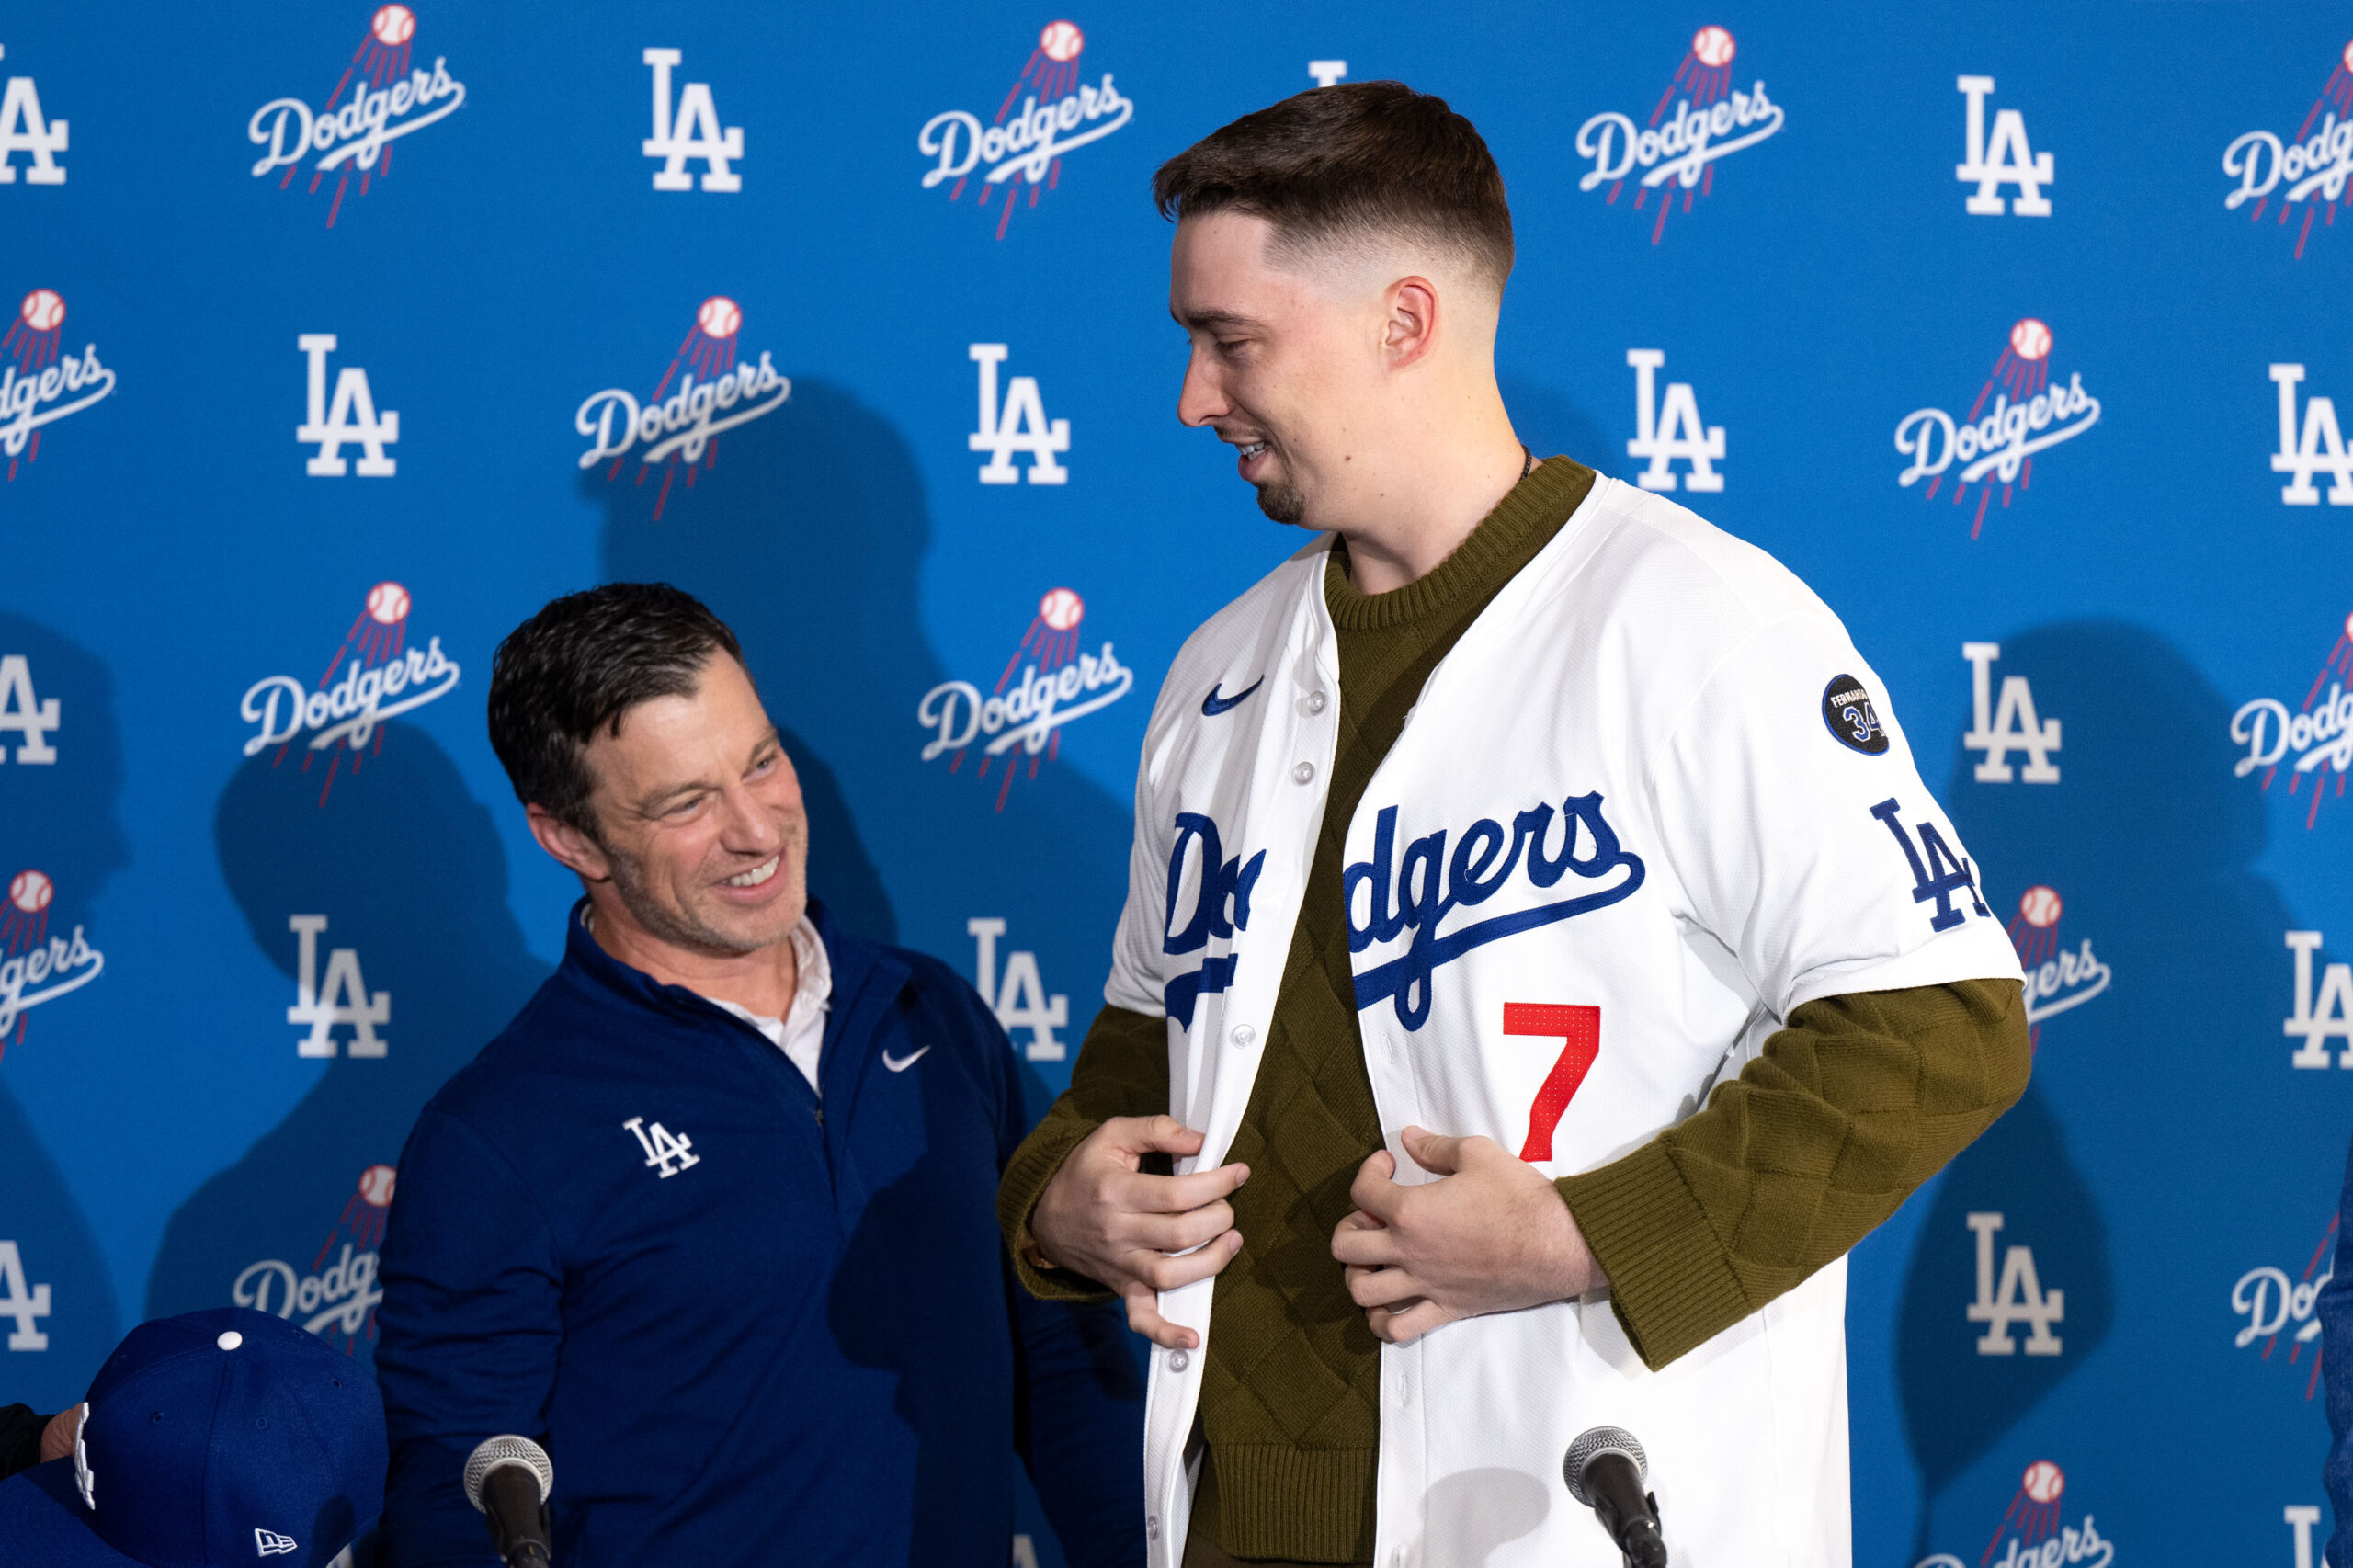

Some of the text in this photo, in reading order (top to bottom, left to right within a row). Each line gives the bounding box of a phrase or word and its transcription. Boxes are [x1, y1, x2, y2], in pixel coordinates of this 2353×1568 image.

[0, 42, 69, 185] A
[248, 56, 466, 177] Dodgers
[642, 47, 745, 192] LA
[918, 74, 1134, 188] Dodgers
[1575, 80, 1785, 192] Dodgers
[1955, 74, 2054, 217] LA
[2222, 112, 2353, 210] Dodg
[0, 343, 117, 457] dgers
[296, 334, 400, 477] LA
[575, 351, 791, 469] Dodgers
[968, 343, 1071, 485] LA
[1626, 348, 1727, 493] LA
[1894, 372, 2101, 487] Dodgers
[2268, 363, 2353, 506] LA
[0, 654, 61, 765] A
[241, 636, 460, 756] Dodgers
[918, 642, 1133, 761] Dodgers
[1843, 701, 1887, 743] 34
[1962, 642, 2063, 784] LA
[2230, 682, 2353, 778] Dodg
[1869, 797, 1992, 933] LA
[0, 924, 106, 1039] gers
[287, 915, 390, 1058] LA
[968, 917, 1069, 1062] LA
[1503, 1002, 1601, 1163] 7
[622, 1116, 701, 1179] LA
[233, 1243, 384, 1335] Dodg
[1967, 1212, 2064, 1355] LA
